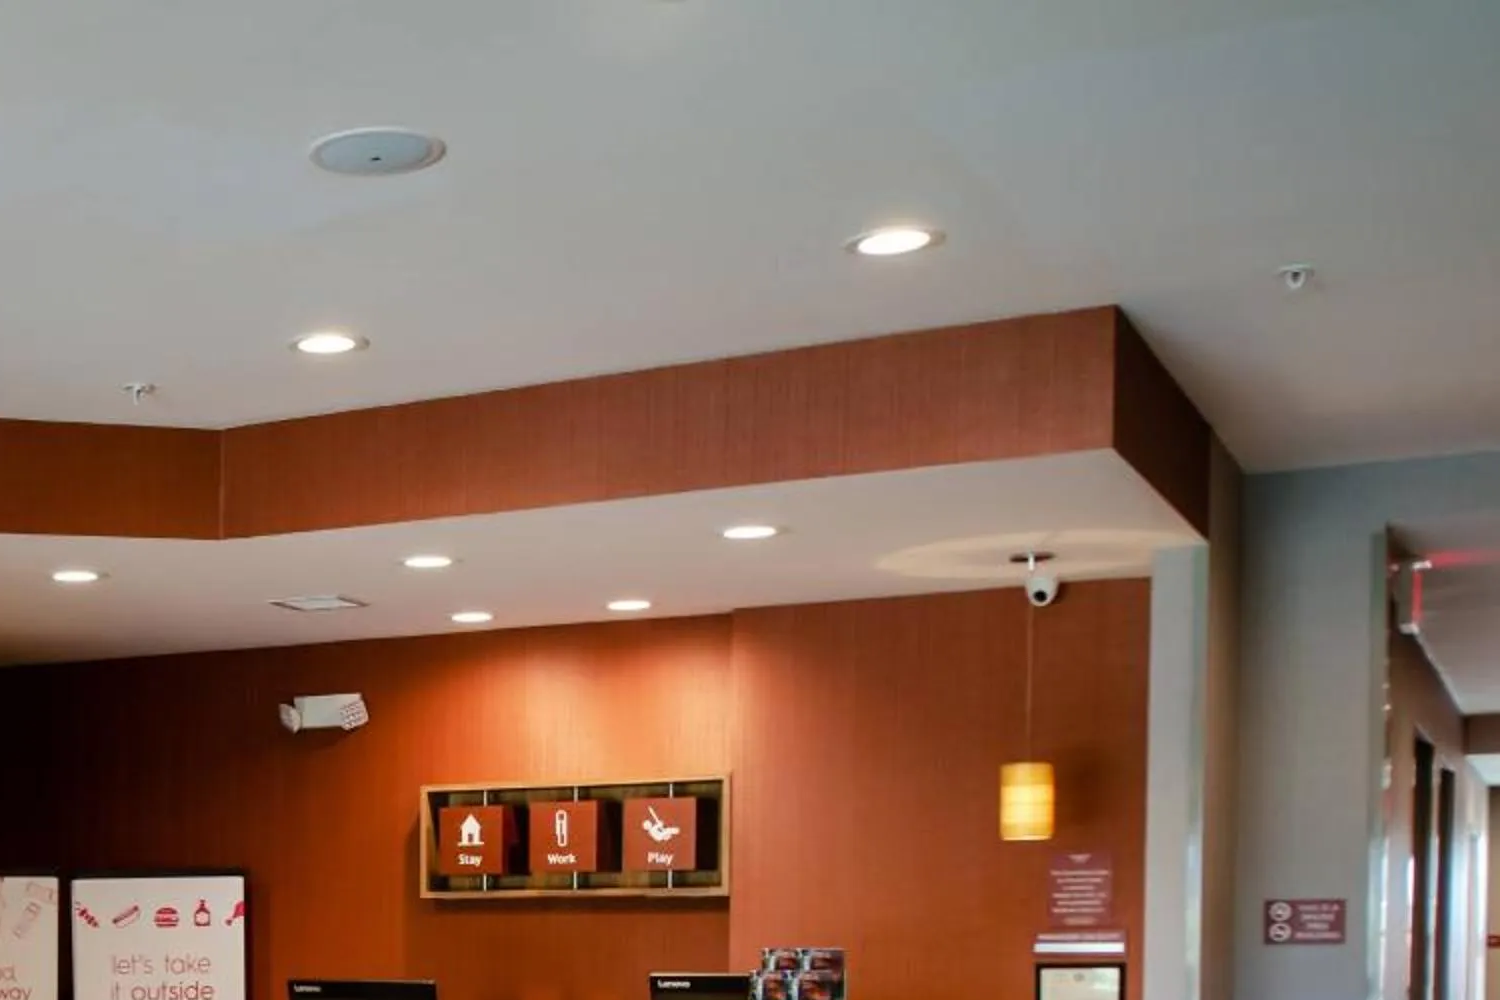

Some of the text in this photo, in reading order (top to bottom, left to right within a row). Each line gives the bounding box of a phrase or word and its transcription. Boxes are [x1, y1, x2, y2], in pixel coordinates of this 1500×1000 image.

[458, 853, 483, 867] Stay
[547, 853, 576, 864] Work
[647, 852, 674, 865] Play
[112, 954, 212, 975] let's take
[110, 981, 215, 1000] it outside
